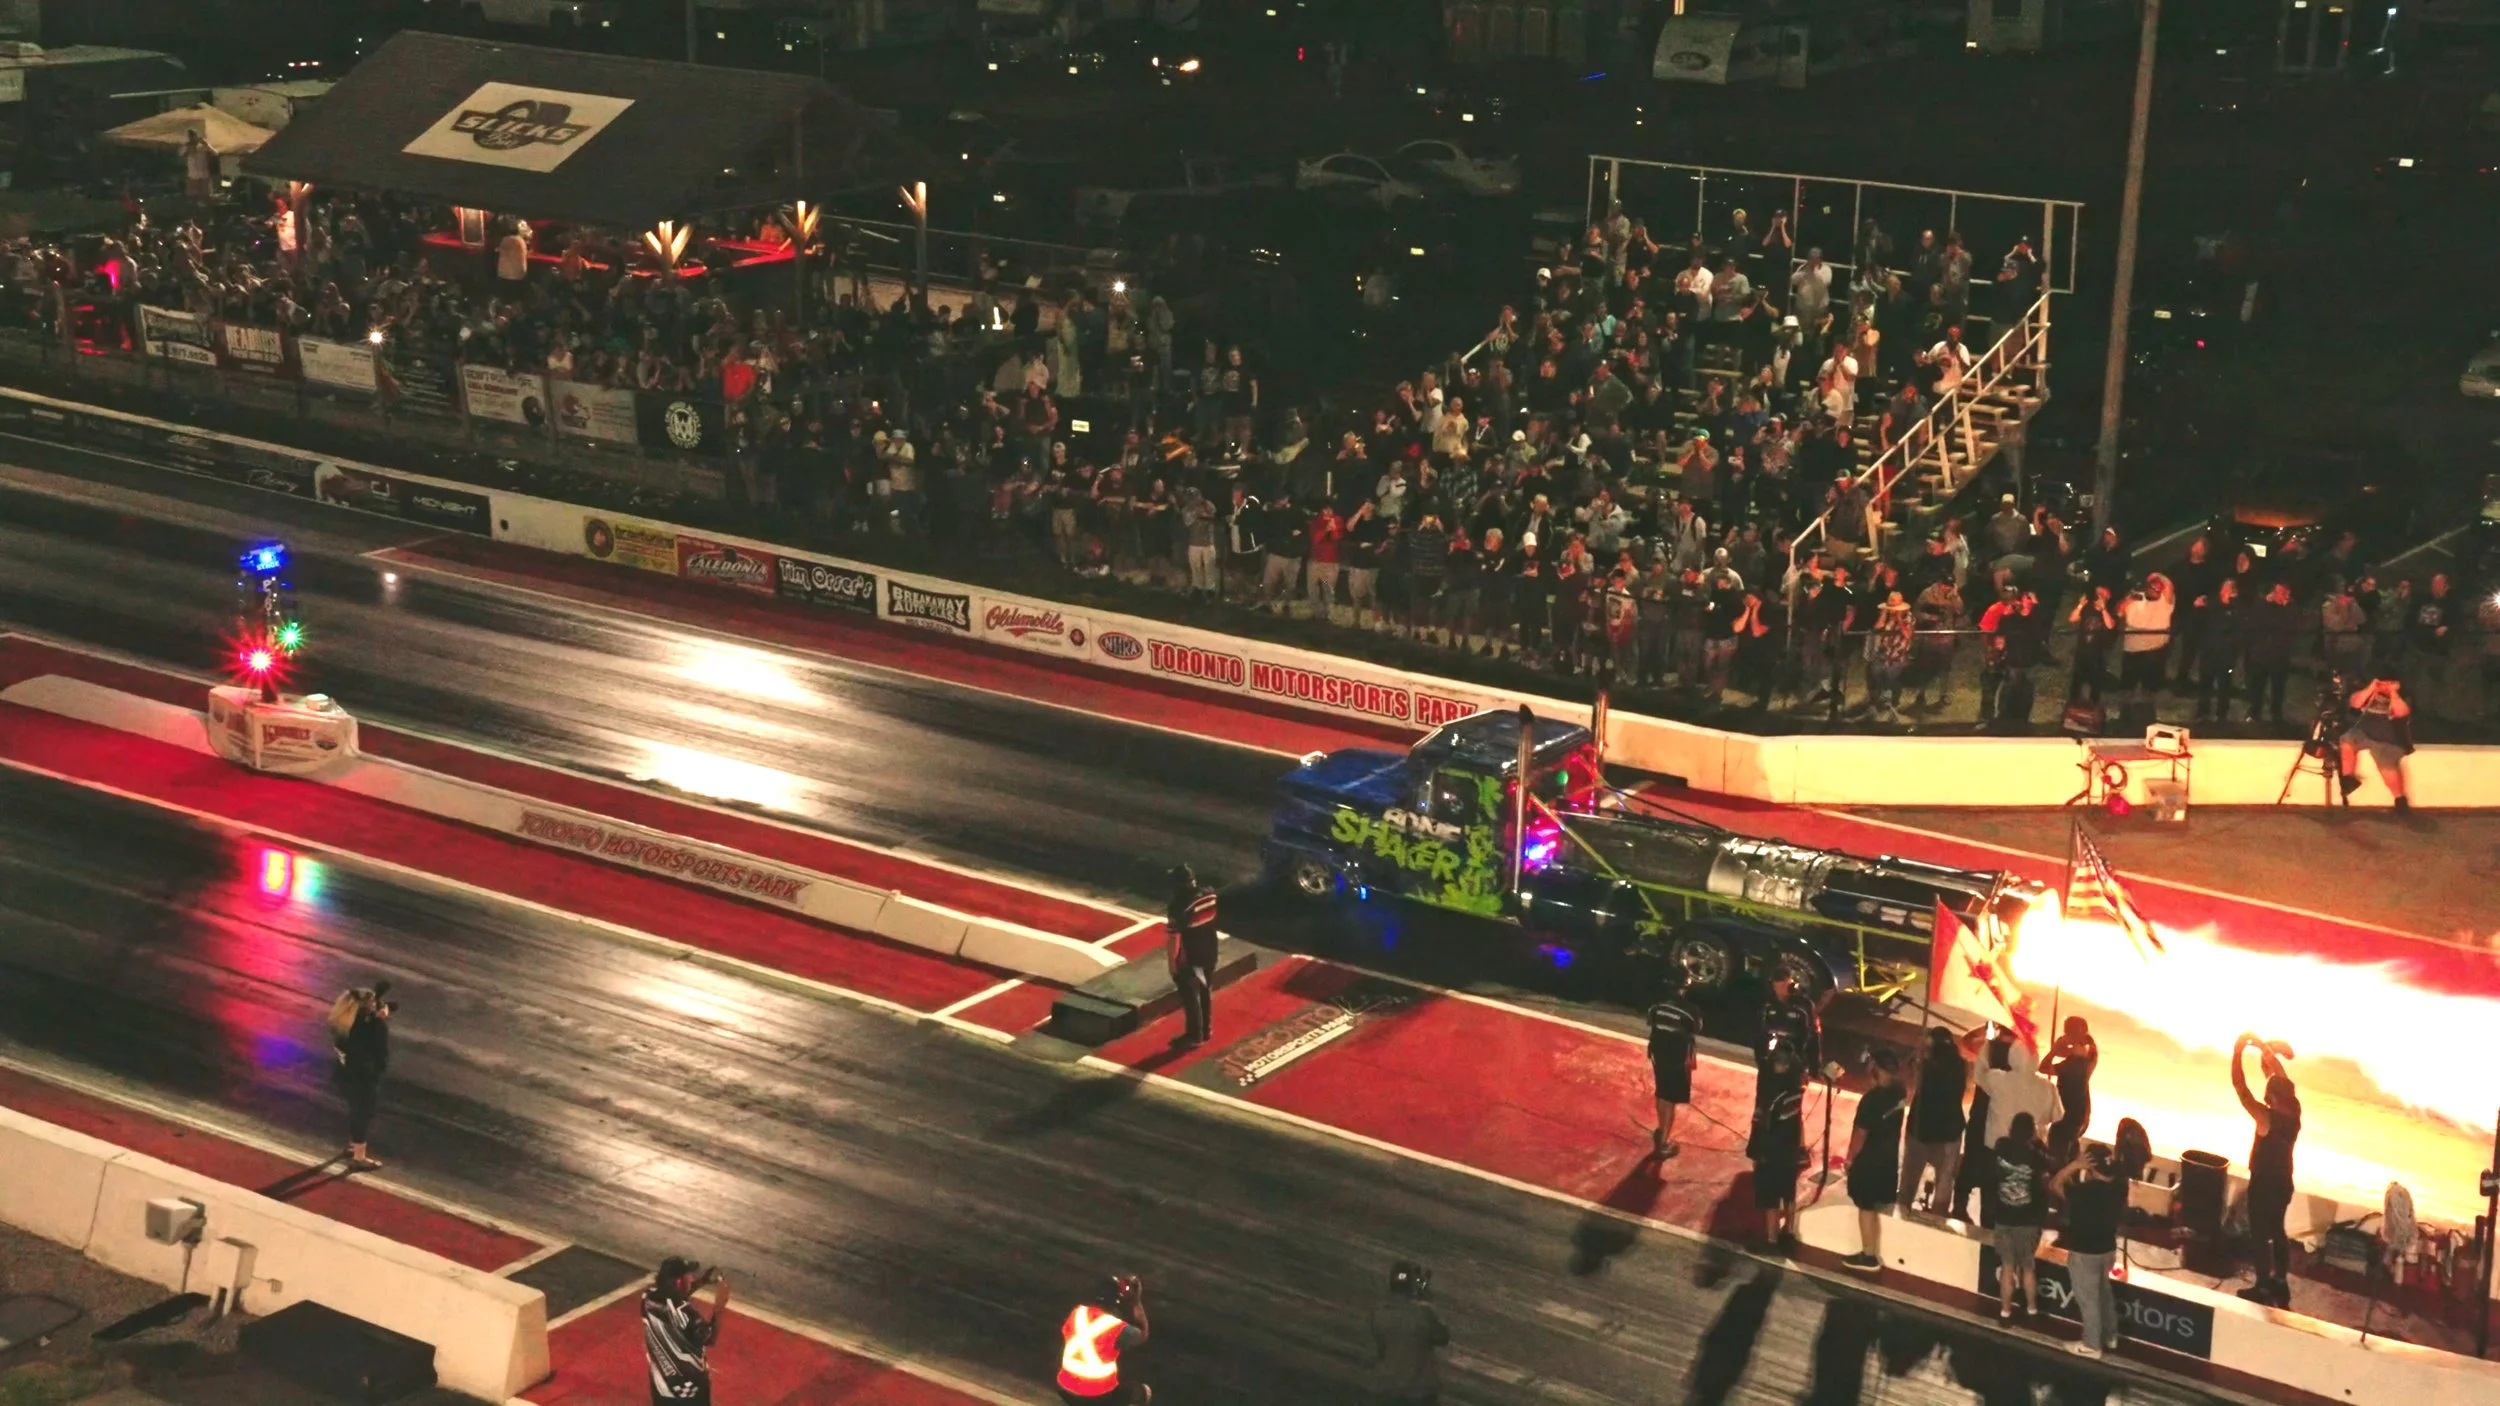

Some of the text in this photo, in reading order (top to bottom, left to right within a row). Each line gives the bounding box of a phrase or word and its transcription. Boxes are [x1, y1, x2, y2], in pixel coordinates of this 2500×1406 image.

[456, 116, 576, 141] SLICKS
[687, 556, 768, 576] CALEDONIA
[779, 558, 812, 592] Tim
[892, 587, 966, 612] BREAKAWAY
[893, 599, 927, 615] AUTO
[929, 606, 967, 627] GLASS
[986, 604, 1064, 633] Oldsmobile
[1102, 635, 1141, 657] NHRA
[1148, 639, 1244, 686] TORONTO
[1250, 659, 1409, 719] MOTORSPORTS
[517, 810, 809, 902] TORONTO MOTORSPORTS PARK
[1331, 810, 1460, 881] SHAKER
[1216, 1004, 1343, 1076] TORONTO
[1244, 1013, 1354, 1071] MOTORSPORTS PARK
